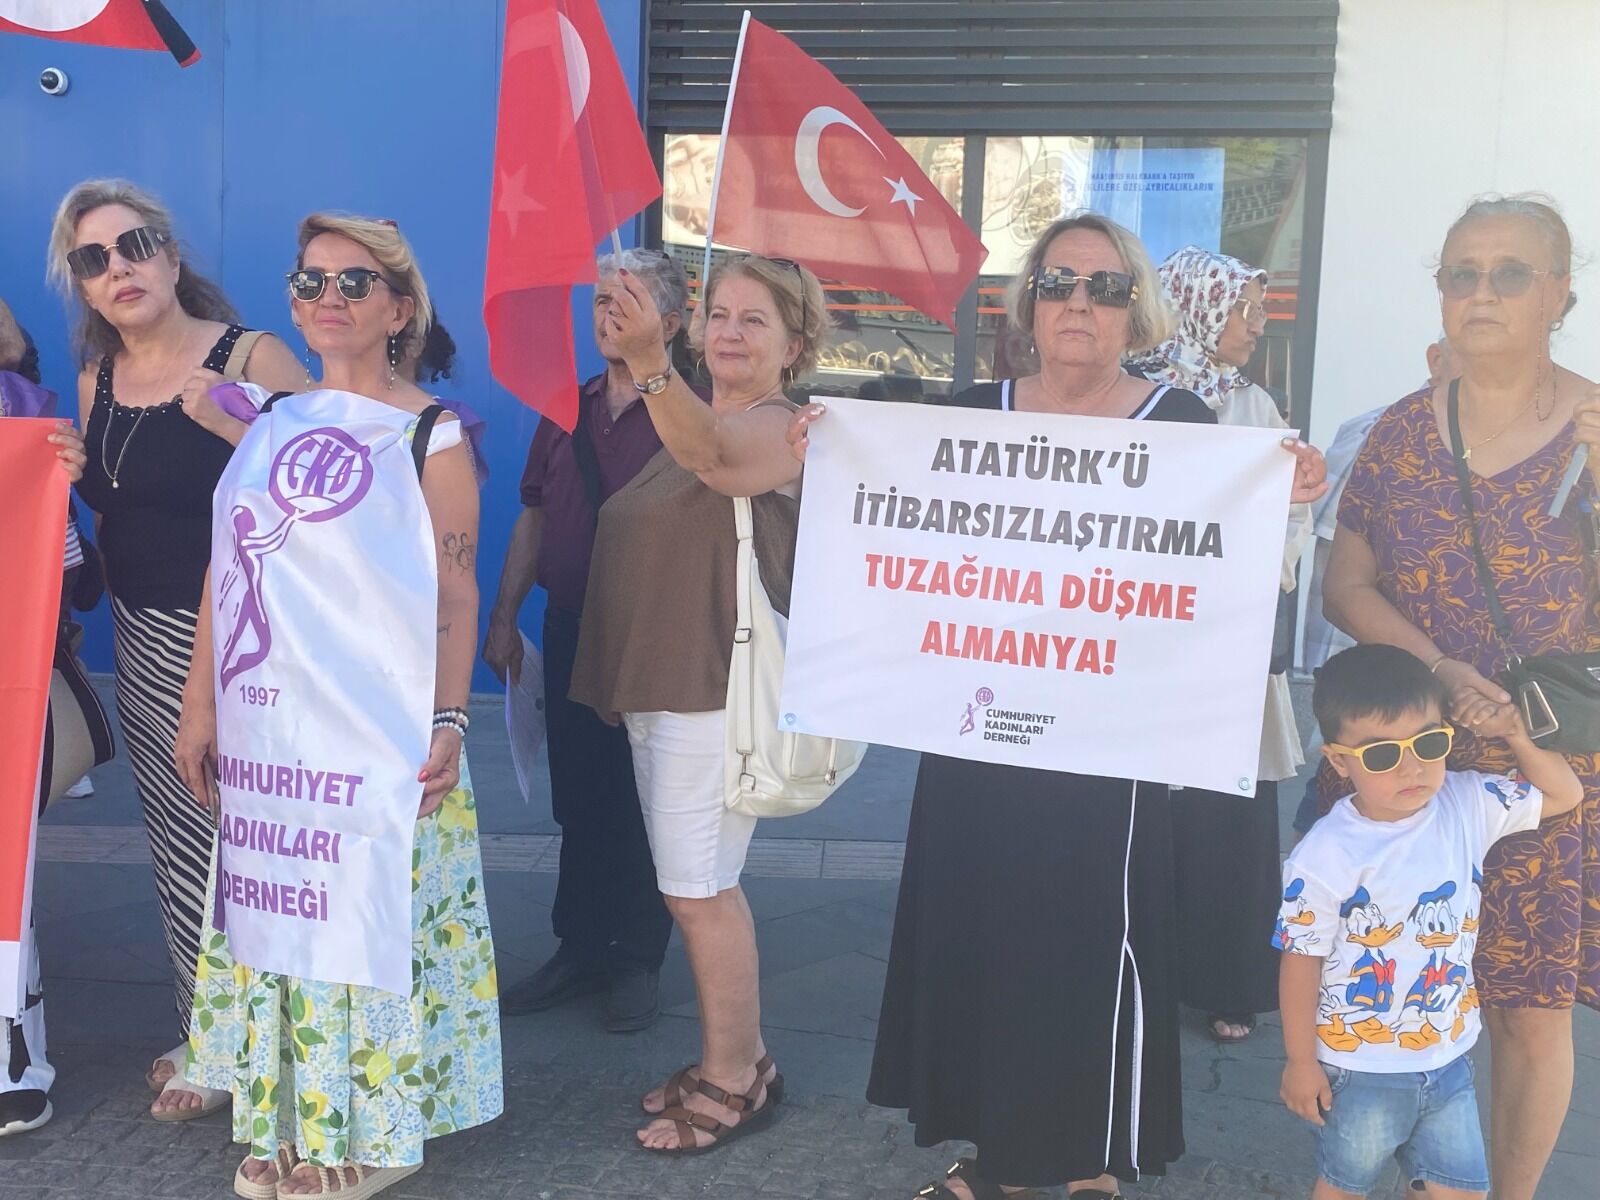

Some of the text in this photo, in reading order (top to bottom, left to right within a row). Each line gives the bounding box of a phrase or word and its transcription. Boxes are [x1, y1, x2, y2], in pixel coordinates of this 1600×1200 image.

[931, 435, 1150, 489] ATATÜRK'Ü
[853, 483, 1223, 559] İTİBARSIZLAŞTIRMA
[866, 554, 1197, 622] TUZAĞINA DÜŞME
[920, 621, 1116, 675] ALMANYA!
[239, 684, 281, 708] 1997
[986, 708, 1056, 725] CUMHURİYET
[983, 731, 1031, 745] DERNEĞİ
[985, 719, 1044, 735] KADINLARI
[223, 869, 328, 922] DERNEĞİ
